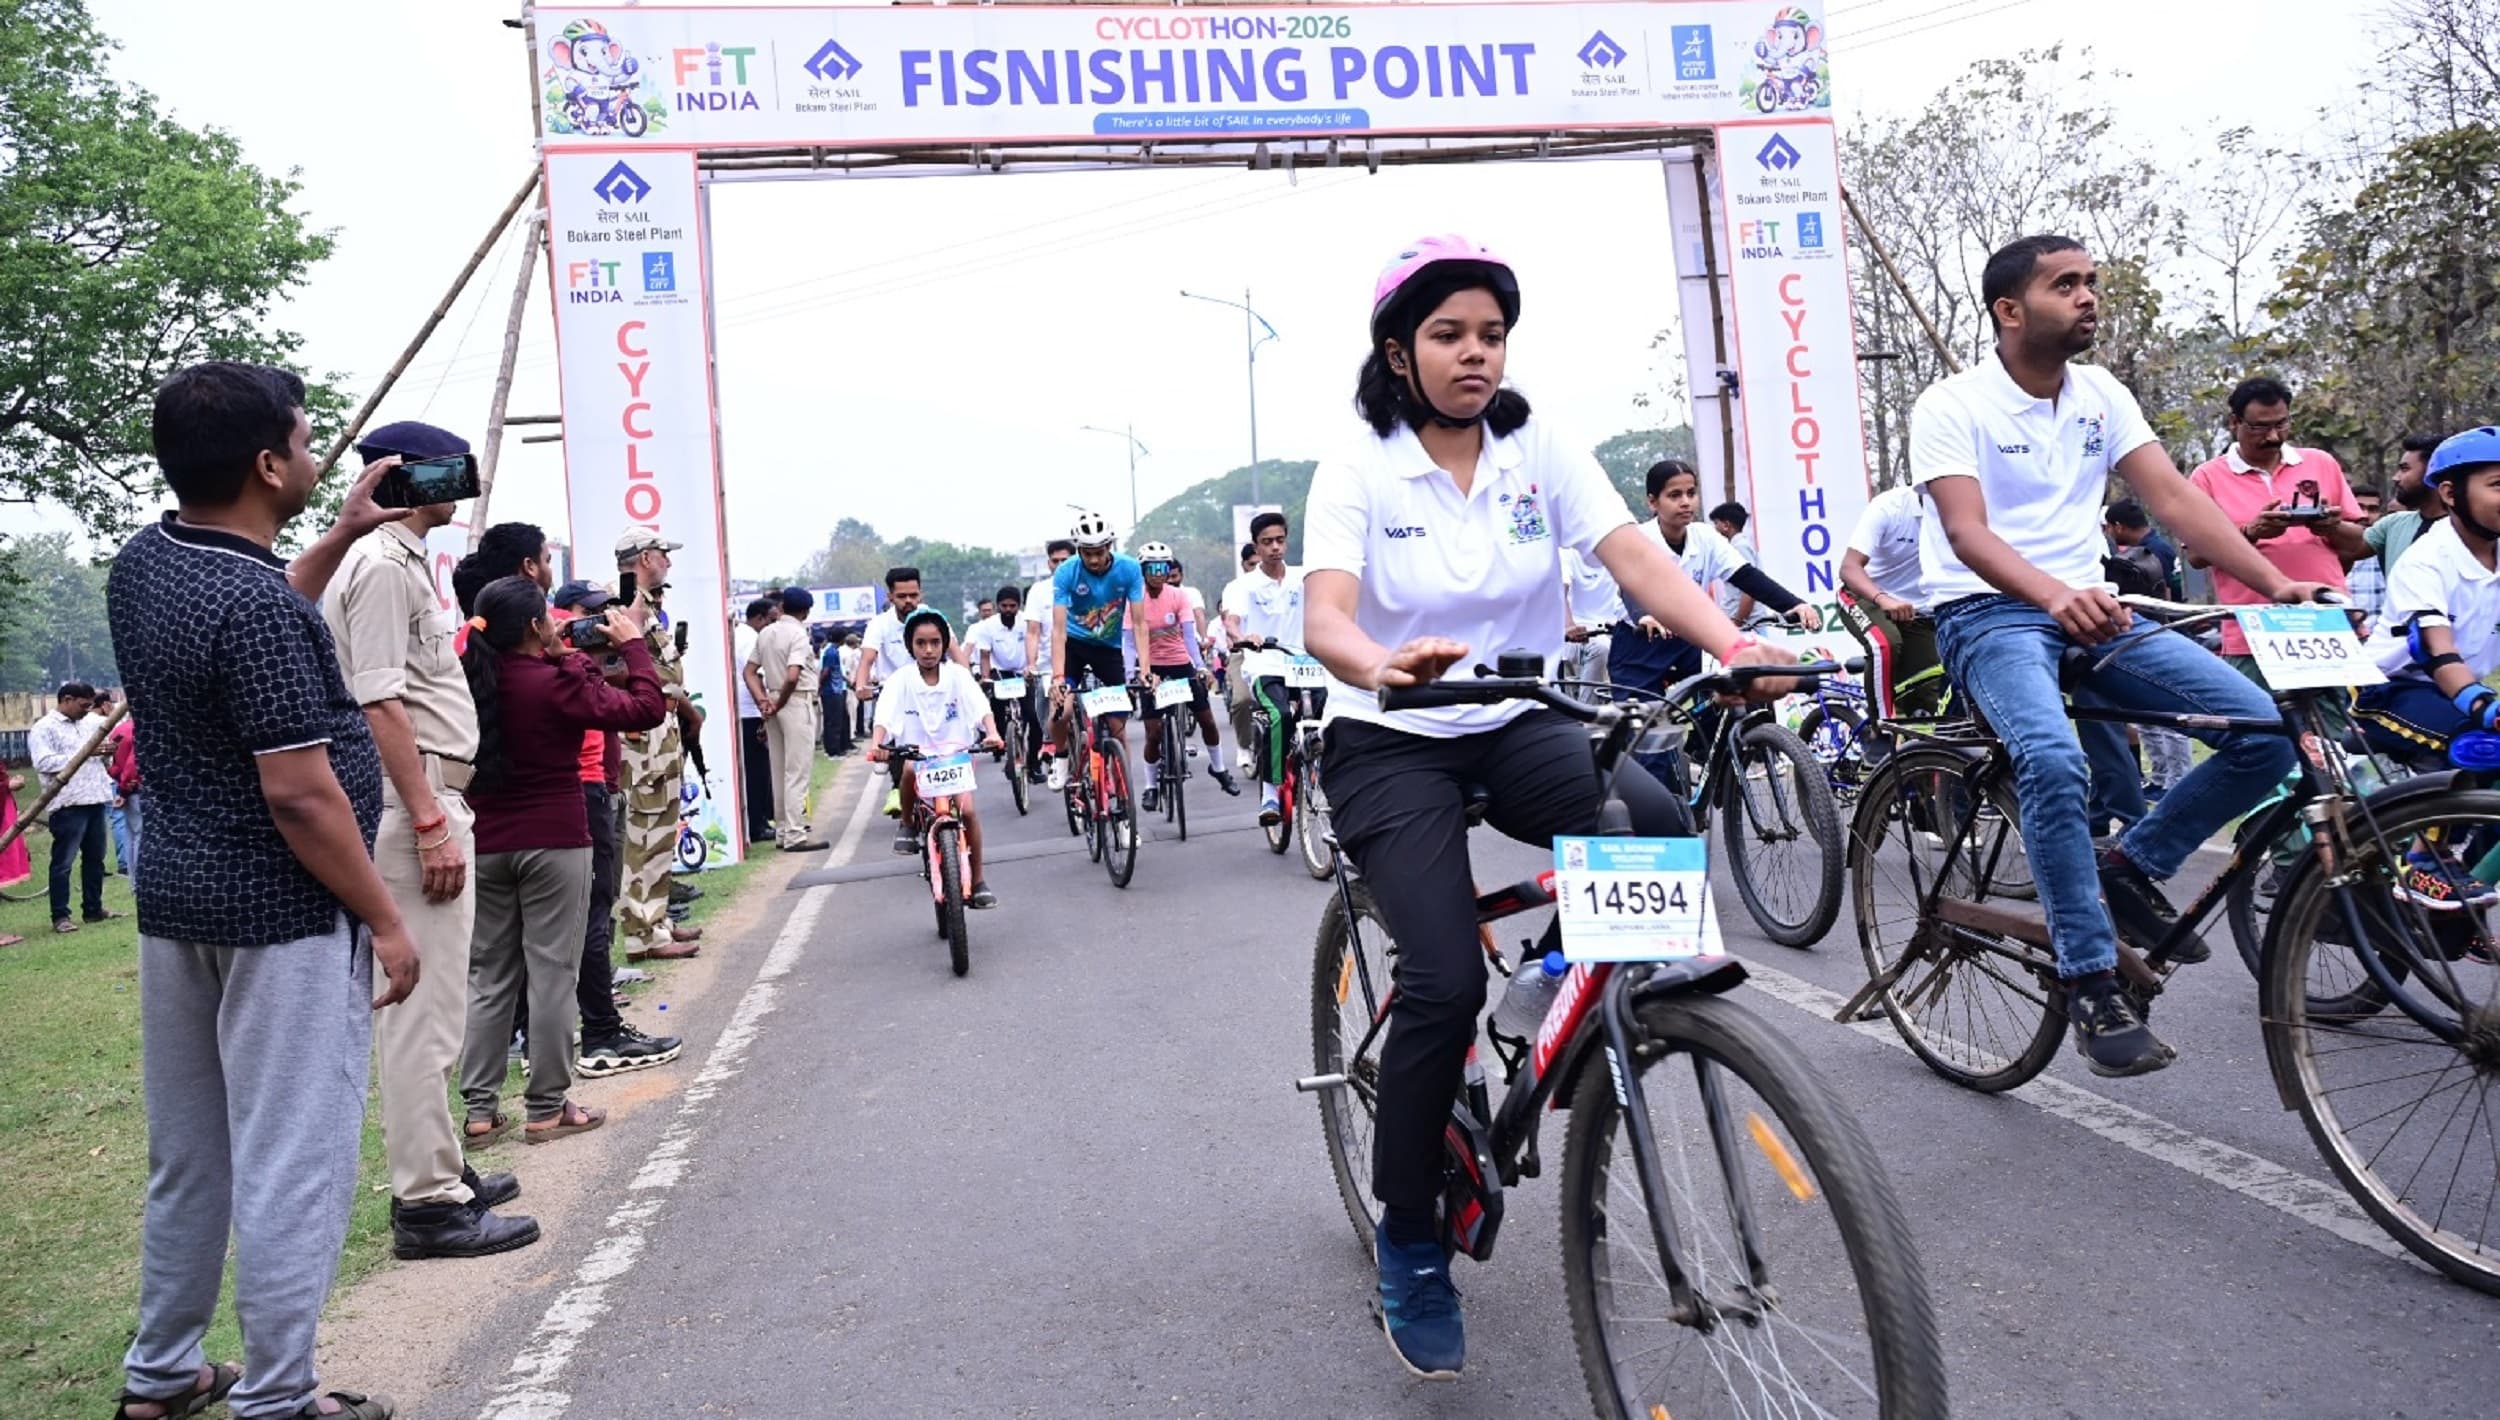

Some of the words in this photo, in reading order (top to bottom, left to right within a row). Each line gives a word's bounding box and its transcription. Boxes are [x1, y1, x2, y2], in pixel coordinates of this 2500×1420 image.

[1096, 16, 1351, 41] CYCLOTHON-2026
[899, 47, 1308, 107] FISNISHING
[1329, 43, 1536, 100] POINT
[677, 91, 760, 111] INDIA
[835, 88, 861, 98] SAIL
[854, 101, 878, 111] Plant
[1111, 116, 1152, 128] There's
[1166, 115, 1192, 127] little
[1194, 115, 1209, 127] bit
[1212, 115, 1224, 129] of
[1266, 113, 1332, 128] everybody's
[624, 211, 651, 223] SAIL
[567, 230, 611, 243] Bokaro
[615, 228, 647, 242] Steel
[650, 227, 683, 240] Plant
[1741, 246, 1783, 259] INDIA
[570, 290, 623, 304] INDIA
[616, 321, 662, 531] CYCLO
[1778, 274, 1834, 593] CYCLOTHON
[1384, 526, 1427, 539] VATS
[2268, 637, 2348, 661] 14538
[1584, 881, 1688, 915] 14594
